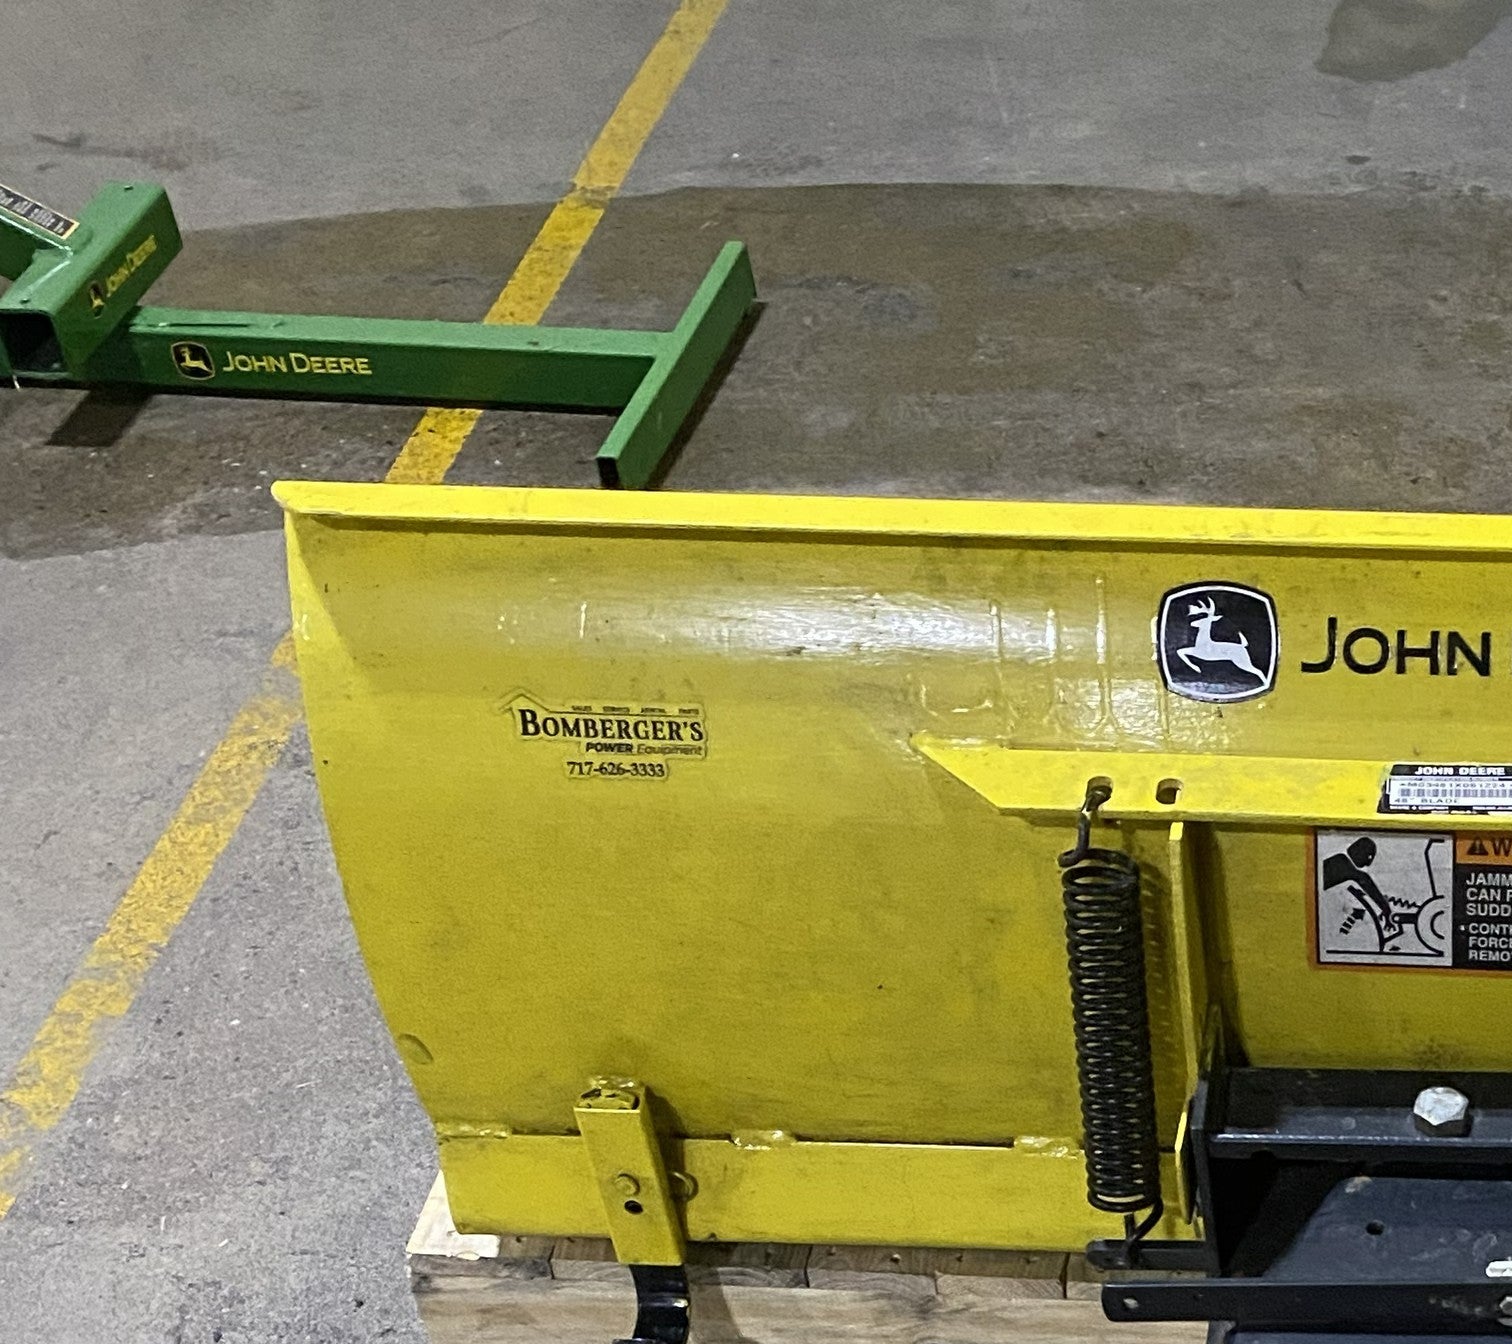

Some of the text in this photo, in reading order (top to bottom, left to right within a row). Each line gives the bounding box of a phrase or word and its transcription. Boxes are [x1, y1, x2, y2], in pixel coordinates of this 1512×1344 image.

[222, 351, 373, 375] JOHN DEERE
[1300, 616, 1492, 677] JOHN
[518, 708, 704, 742] BOMBERGER'S
[585, 742, 702, 756] POWER Equipment
[567, 761, 665, 777] 717-626-3333
[1414, 766, 1506, 776] JOHN DEERE
[1465, 888, 1501, 901] CAN
